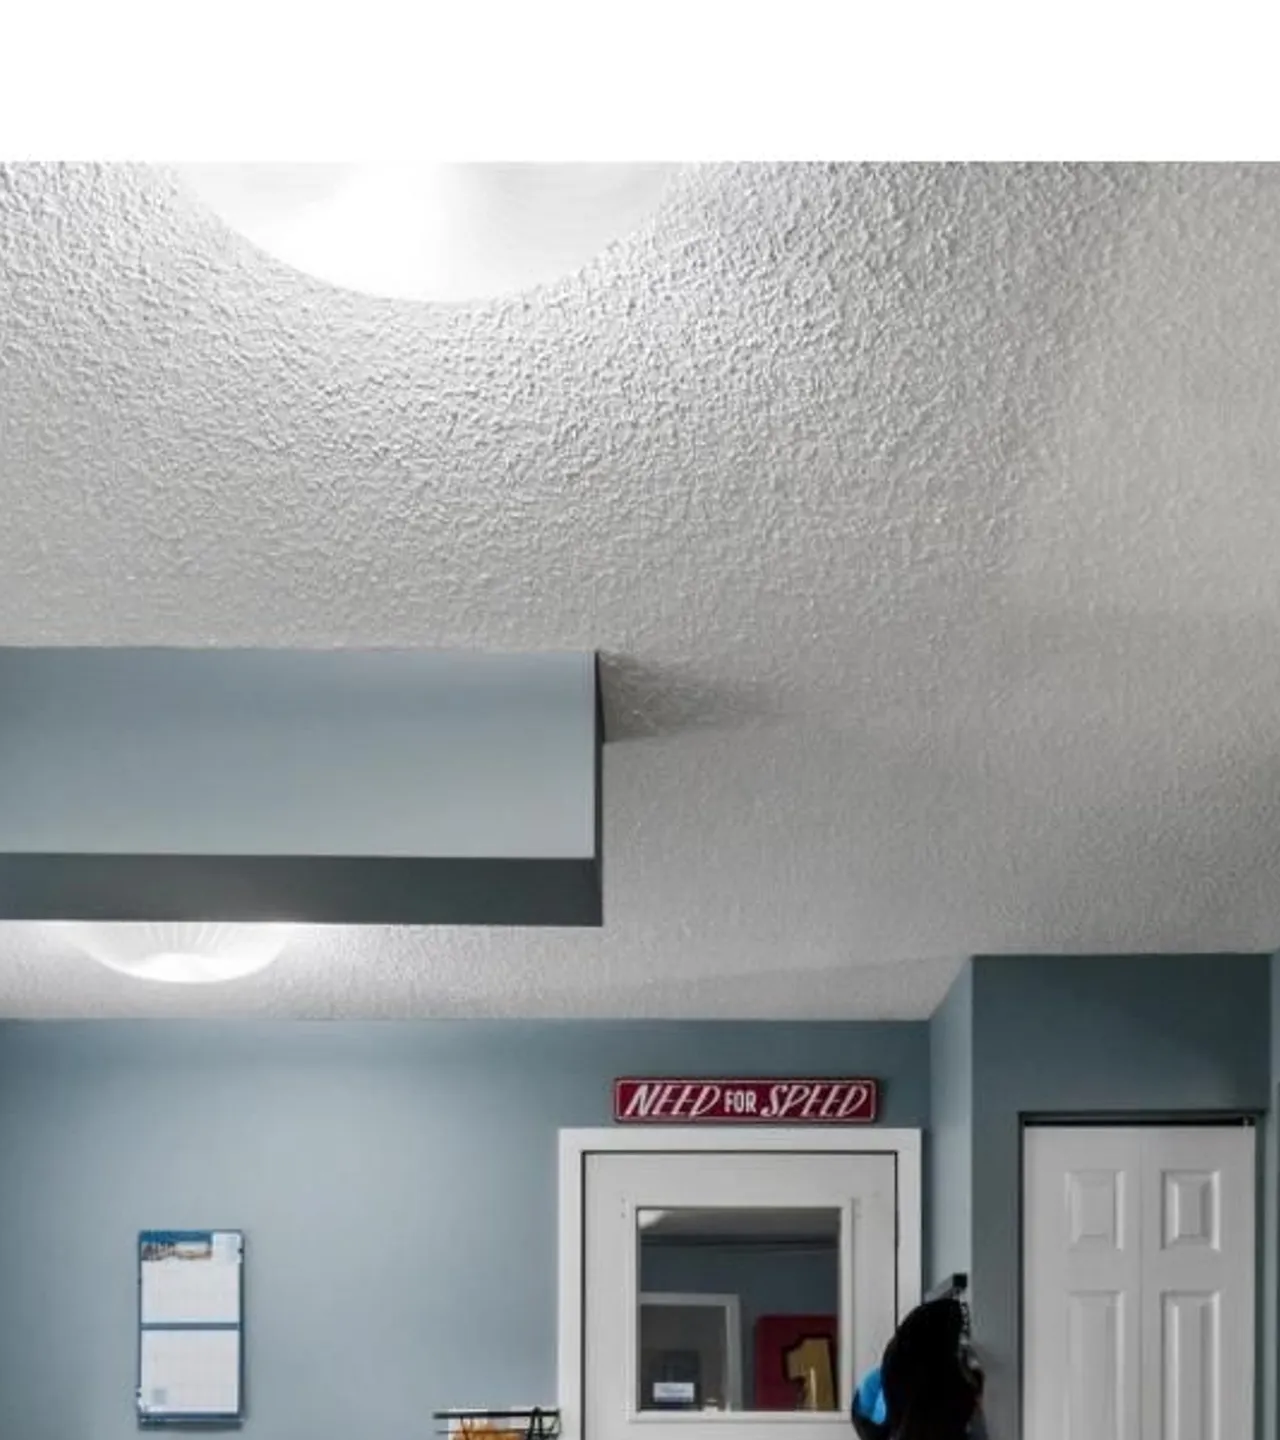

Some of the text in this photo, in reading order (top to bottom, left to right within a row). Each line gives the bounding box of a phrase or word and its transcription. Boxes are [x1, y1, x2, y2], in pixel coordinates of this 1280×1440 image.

[624, 1083, 869, 1117] NEED FOR SPEED
